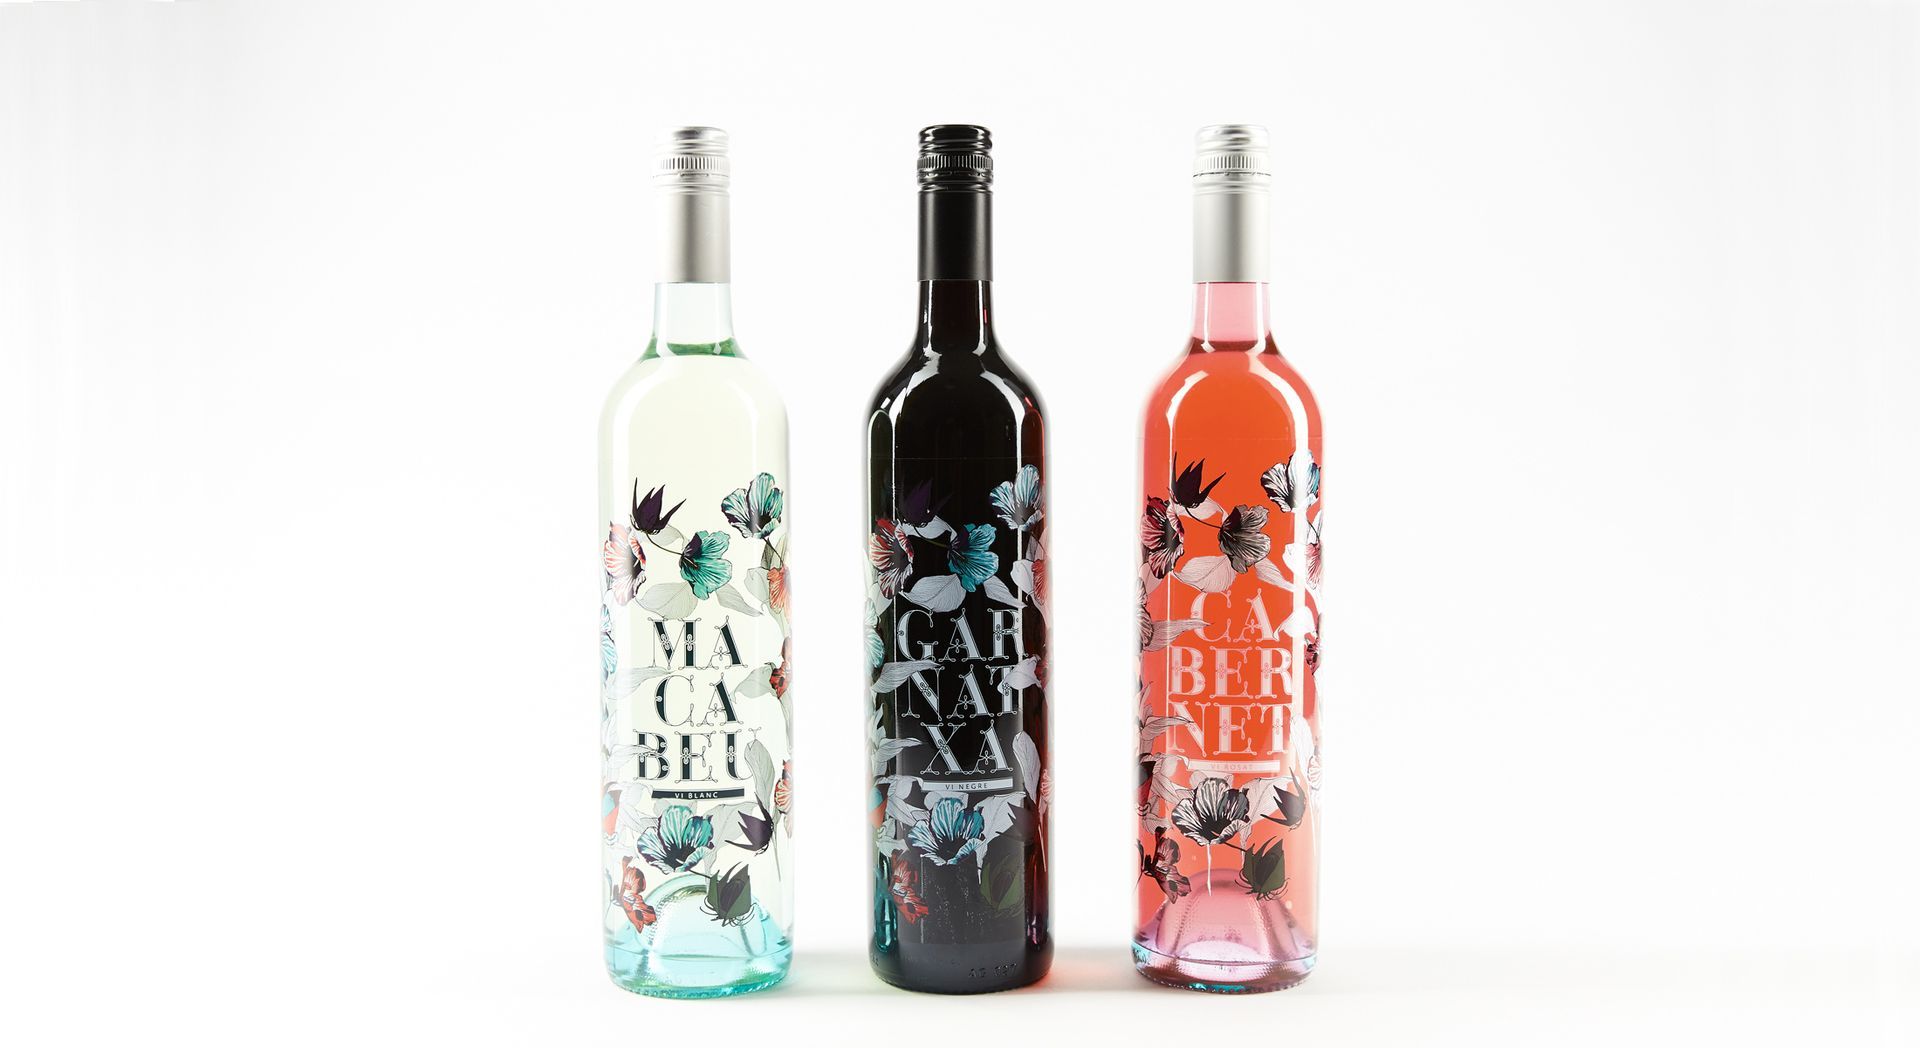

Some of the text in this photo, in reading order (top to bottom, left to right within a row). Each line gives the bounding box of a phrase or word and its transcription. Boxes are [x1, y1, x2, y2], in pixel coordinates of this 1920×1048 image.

[648, 615, 748, 669] MA
[897, 608, 1029, 662] GAR
[1190, 587, 1280, 642] CA
[654, 672, 744, 727] CA
[901, 664, 1018, 721] NAT
[1168, 645, 1293, 699] BER
[632, 727, 762, 783] BEU
[920, 719, 1014, 775] XA
[1168, 700, 1293, 757] NET
[674, 791, 719, 799] VI BLANC
[958, 782, 988, 790] NEGRE
